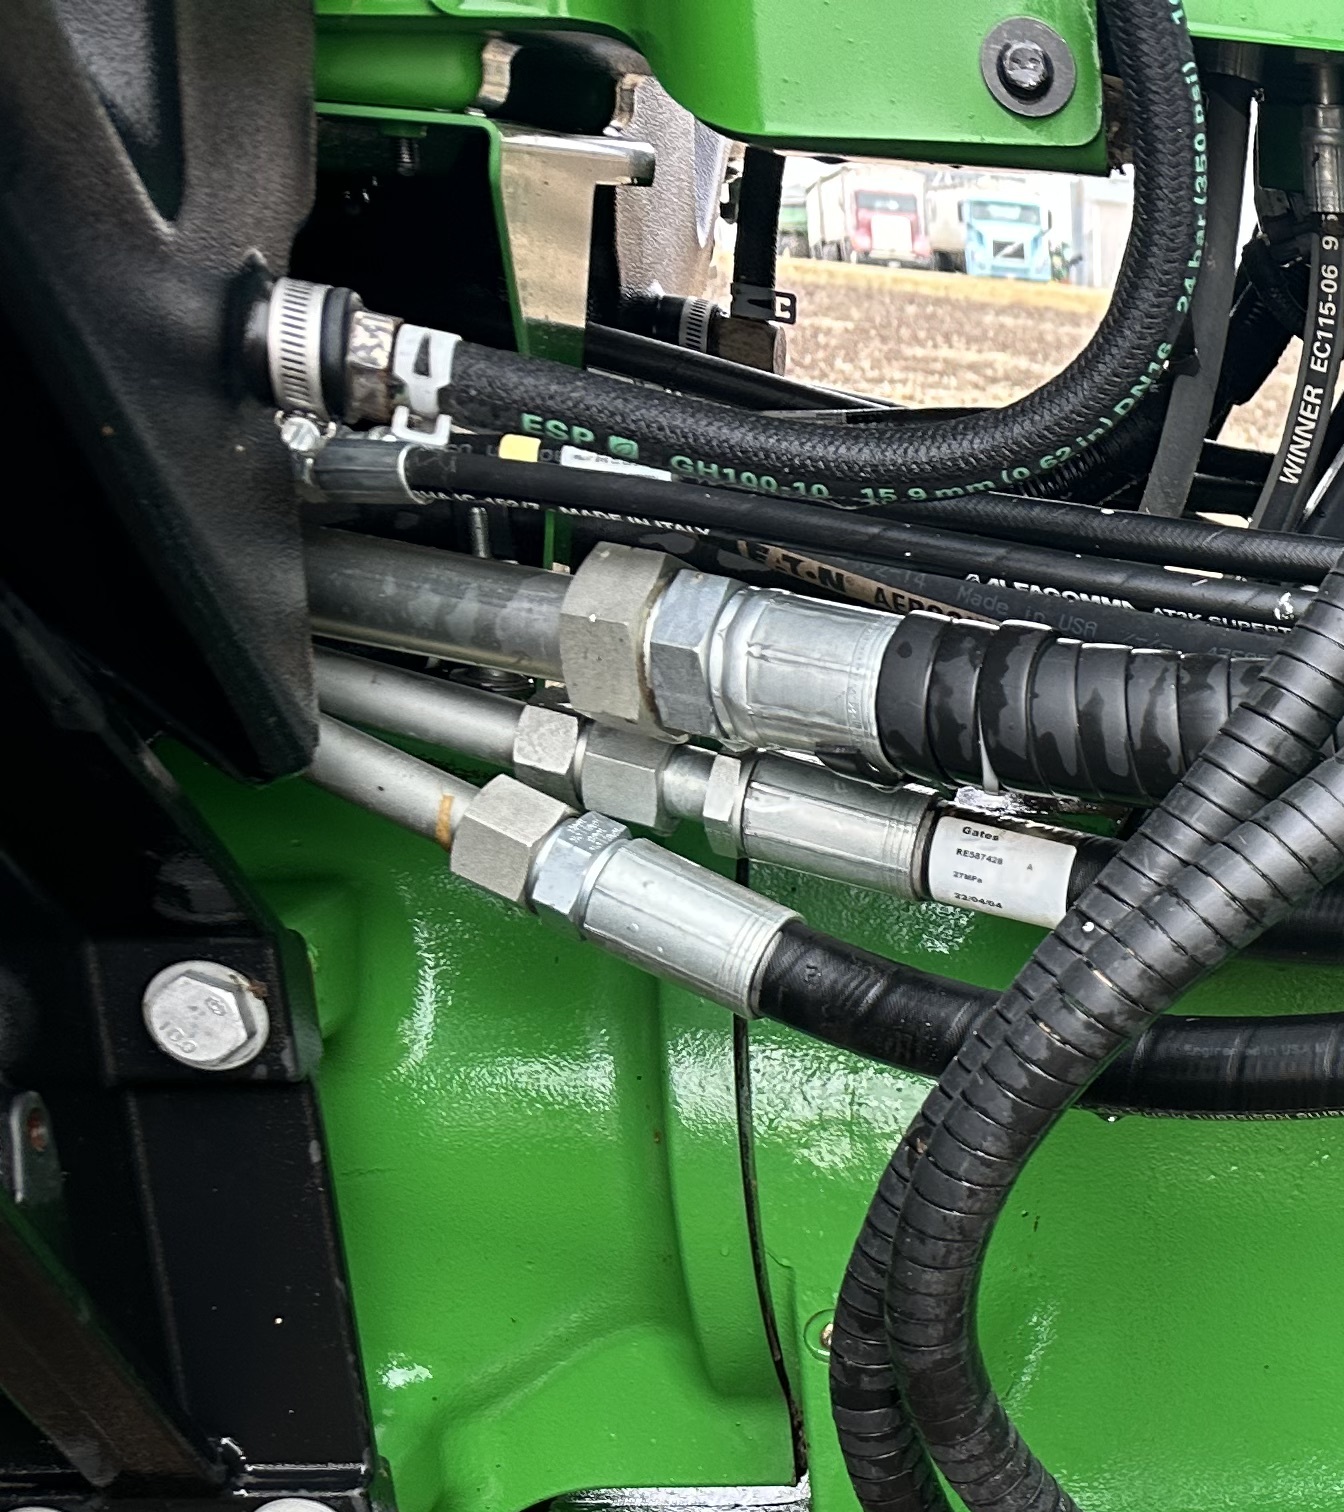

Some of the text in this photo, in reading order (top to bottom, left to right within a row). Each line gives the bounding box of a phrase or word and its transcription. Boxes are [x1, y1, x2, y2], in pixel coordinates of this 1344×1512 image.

[1181, 61, 1206, 124] psi)
[1193, 132, 1208, 205] (350
[1187, 214, 1206, 268] bar
[1176, 276, 1197, 313] 24
[1279, 384, 1323, 484] WINNER
[1309, 264, 1339, 373] EC115-06
[521, 412, 595, 444] ESP
[1076, 416, 1113, 447] in)
[670, 455, 829, 498] GH100-10
[936, 479, 996, 498] mm
[954, 586, 1010, 617] Made
[1057, 613, 1098, 638] USA
[962, 826, 1000, 842] Gates
